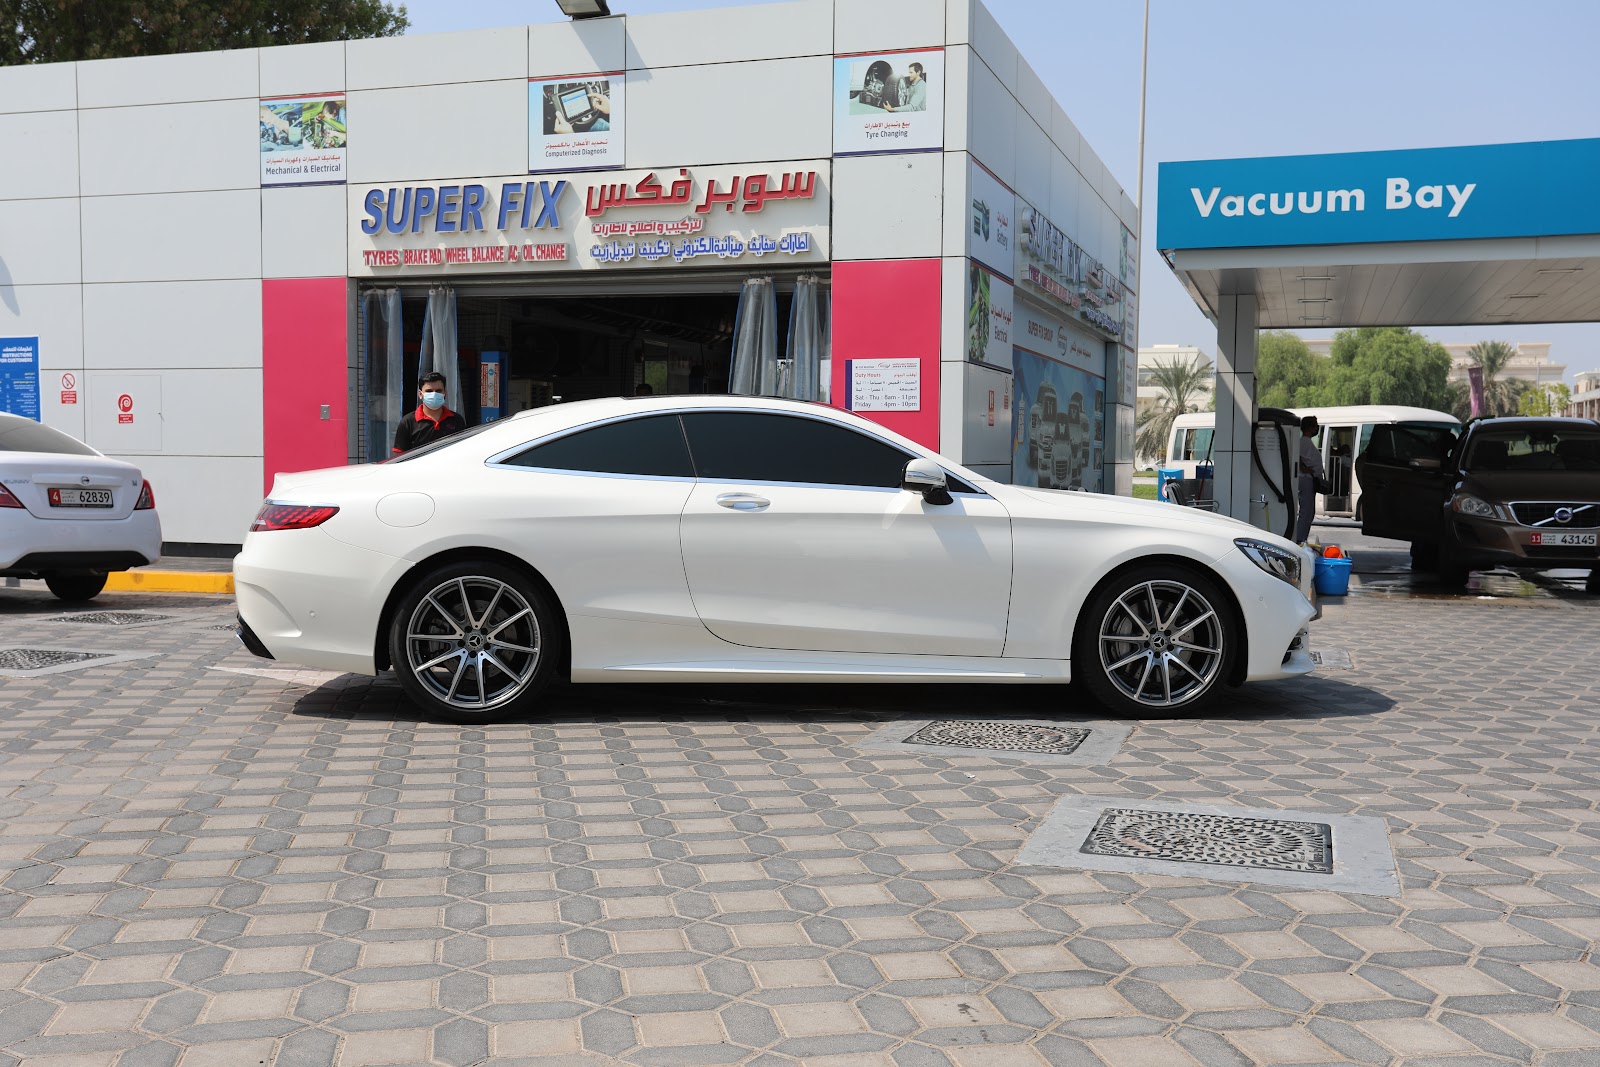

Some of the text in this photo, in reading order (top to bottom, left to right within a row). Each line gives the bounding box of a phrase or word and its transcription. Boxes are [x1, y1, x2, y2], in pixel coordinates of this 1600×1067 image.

[866, 130, 908, 139] Tyre Changing
[545, 148, 607, 157] Computerized Diagnosis
[266, 163, 341, 175] Mechanical & Electrical
[585, 168, 816, 217] سوبر فكس
[1190, 177, 1477, 218] Vacuum Bay
[361, 180, 568, 235] SUPER FIX
[747, 235, 776, 256] سفايف
[779, 233, 808, 253] اطارات
[996, 228, 1008, 251] Battery
[1027, 208, 1064, 273] SUPER
[364, 243, 565, 266] TYRES BRAKE PAD WHEEL BALANCE AC OIL CHANGE
[638, 240, 670, 261] تكييف
[994, 325, 1008, 343] Electrical
[1028, 319, 1039, 337] SUPER
[855, 401, 871, 409] Friday
[53, 492, 59, 501] 4
[79, 491, 110, 503] 62839
[1532, 535, 1540, 543] 11
[1561, 535, 1595, 545] 43145
